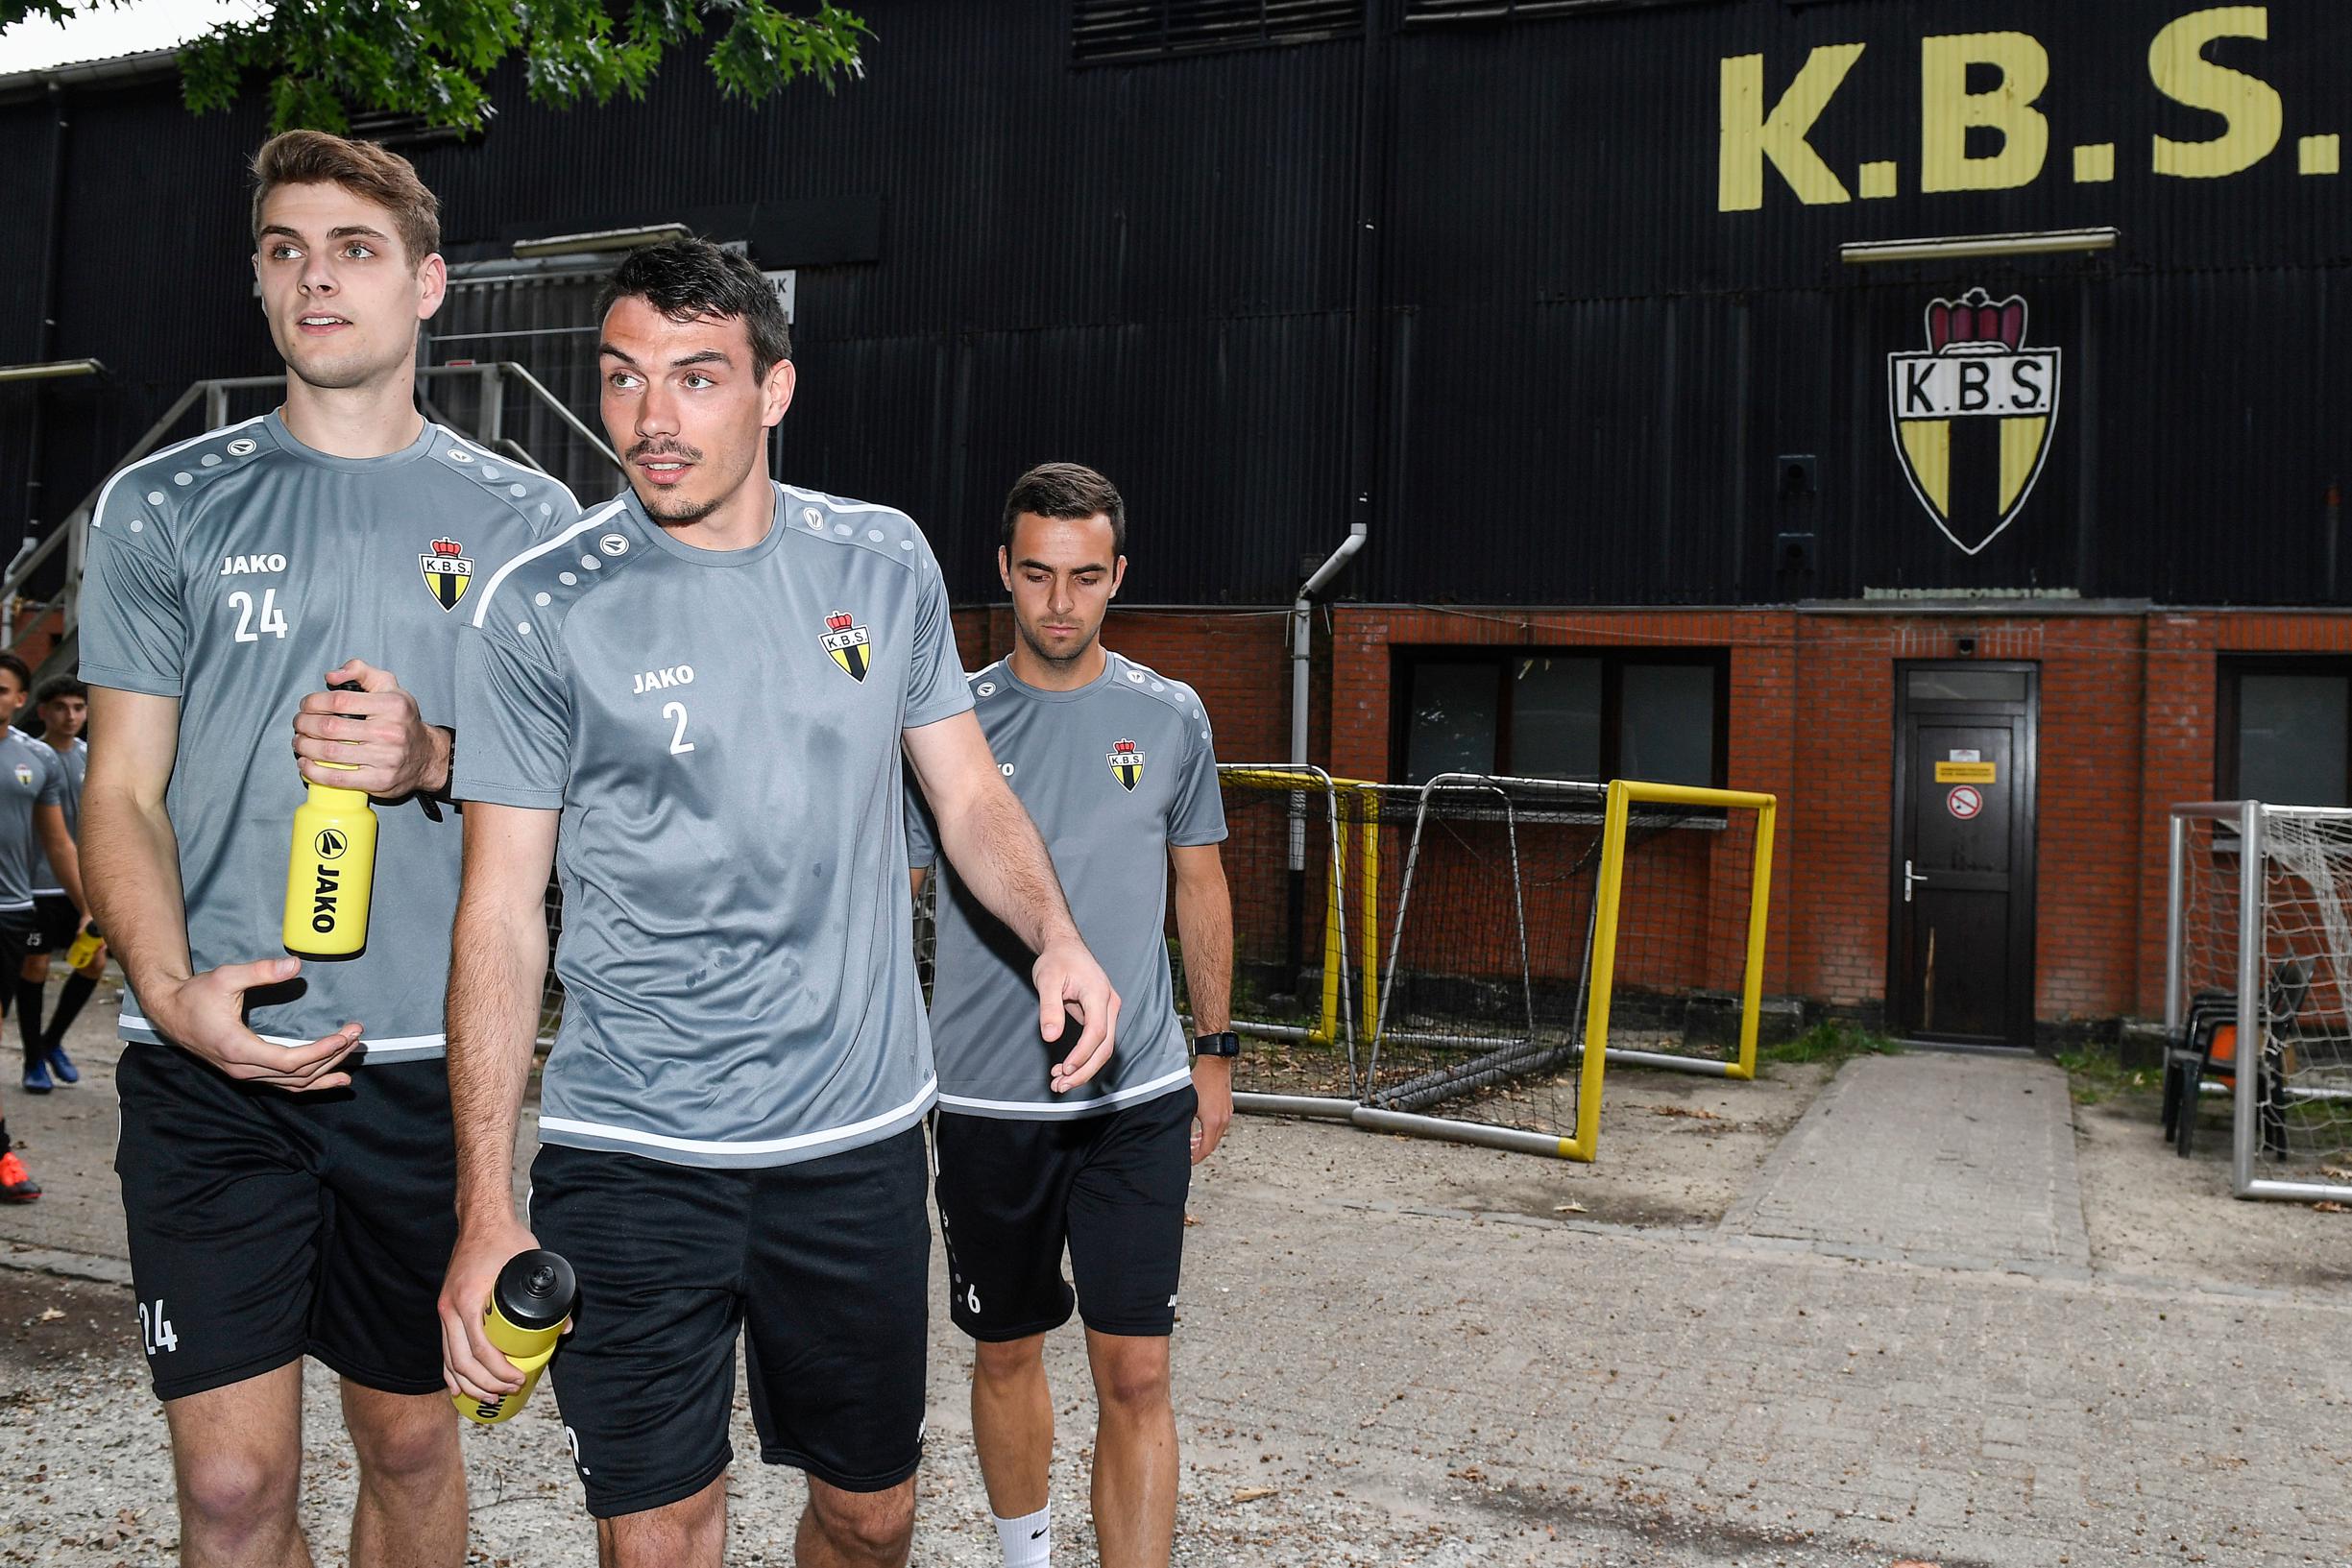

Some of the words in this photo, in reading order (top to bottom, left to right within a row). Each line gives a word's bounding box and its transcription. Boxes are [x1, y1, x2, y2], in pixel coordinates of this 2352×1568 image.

[1717, 6, 2340, 212] K.B.S.
[1906, 359, 2047, 413] K.B.S.
[220, 554, 287, 575] JAKO
[426, 560, 471, 574] K.B.S.
[229, 588, 288, 642] 24
[827, 632, 867, 648] K.B.S.
[633, 664, 694, 694] JAKO
[662, 701, 695, 756] 2
[1111, 756, 1143, 765] K.B.S.
[312, 864, 340, 933] JAKO
[967, 1283, 981, 1314] 6
[138, 1298, 179, 1355] 24
